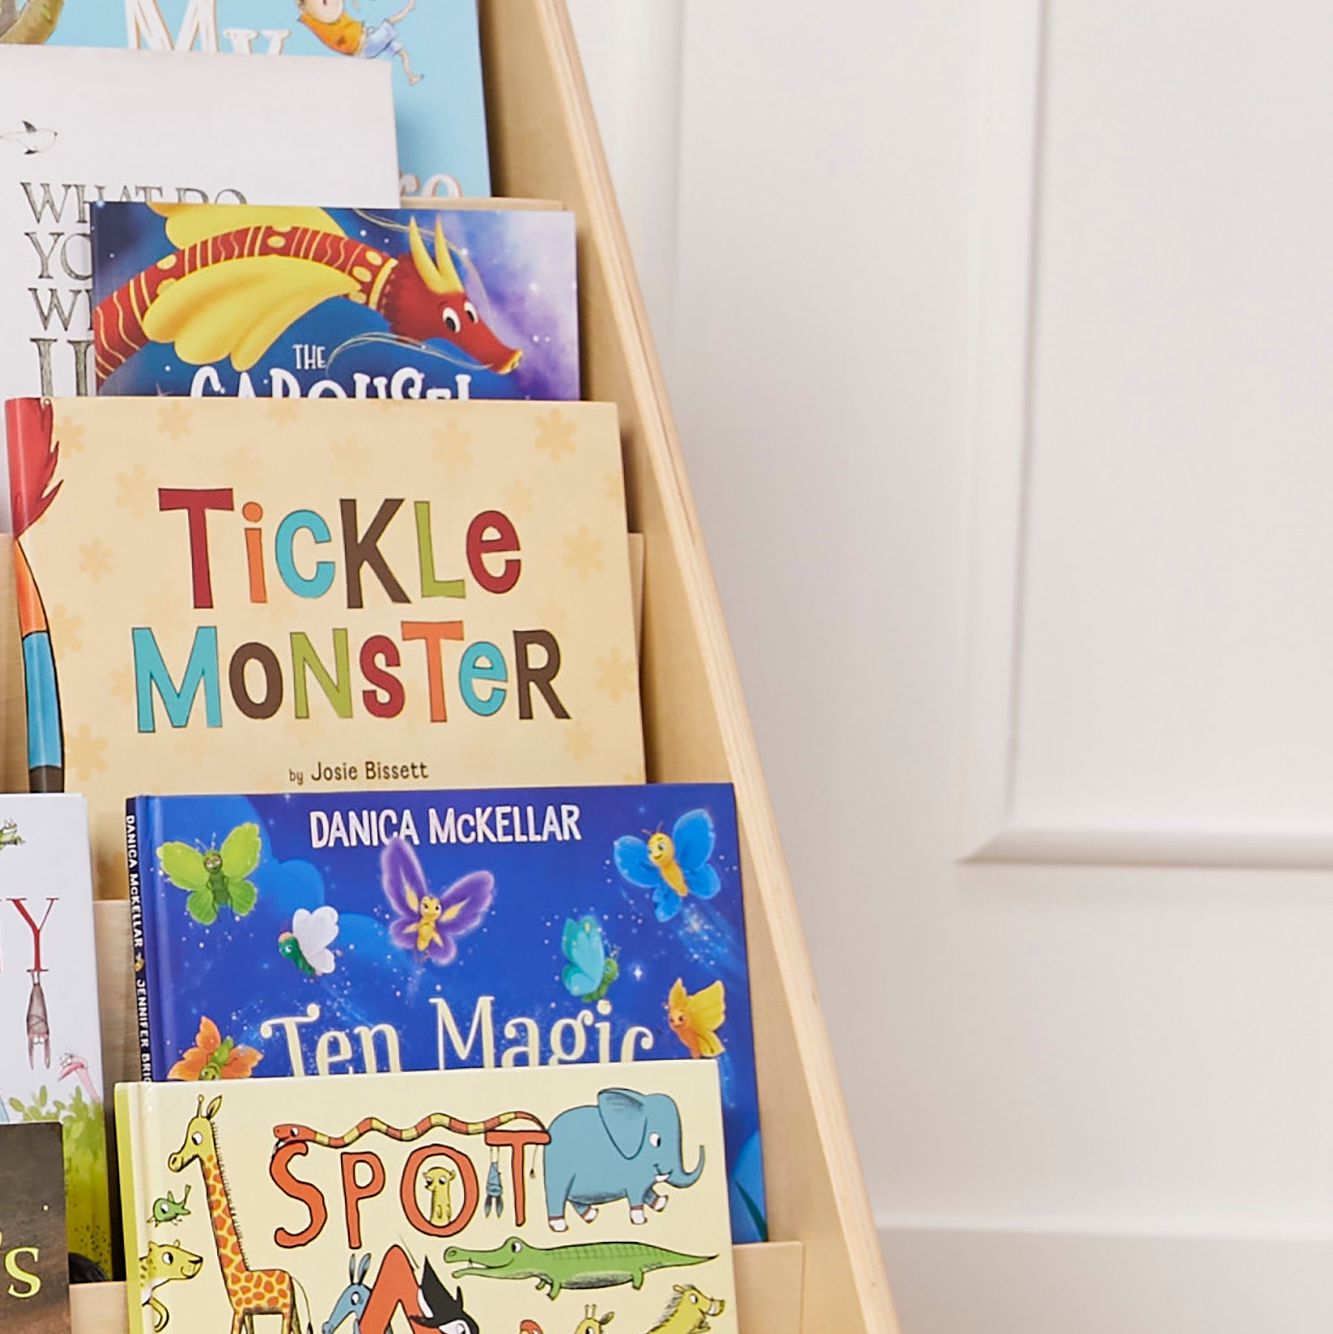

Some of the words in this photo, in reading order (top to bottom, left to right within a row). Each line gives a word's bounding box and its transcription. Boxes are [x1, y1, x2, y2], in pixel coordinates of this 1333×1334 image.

[293, 344, 326, 370] THE
[288, 768, 305, 785] by
[310, 762, 361, 784] Josie
[365, 760, 430, 781] Bissett
[126, 815, 137, 868] DANICA
[309, 807, 419, 849] DANICA
[428, 803, 582, 844] McKELLAR
[130, 874, 143, 948] McKELLAR
[136, 979, 149, 1047] JENNIFER
[260, 1003, 402, 1079] Ten
[270, 1128, 551, 1249] SPOT
